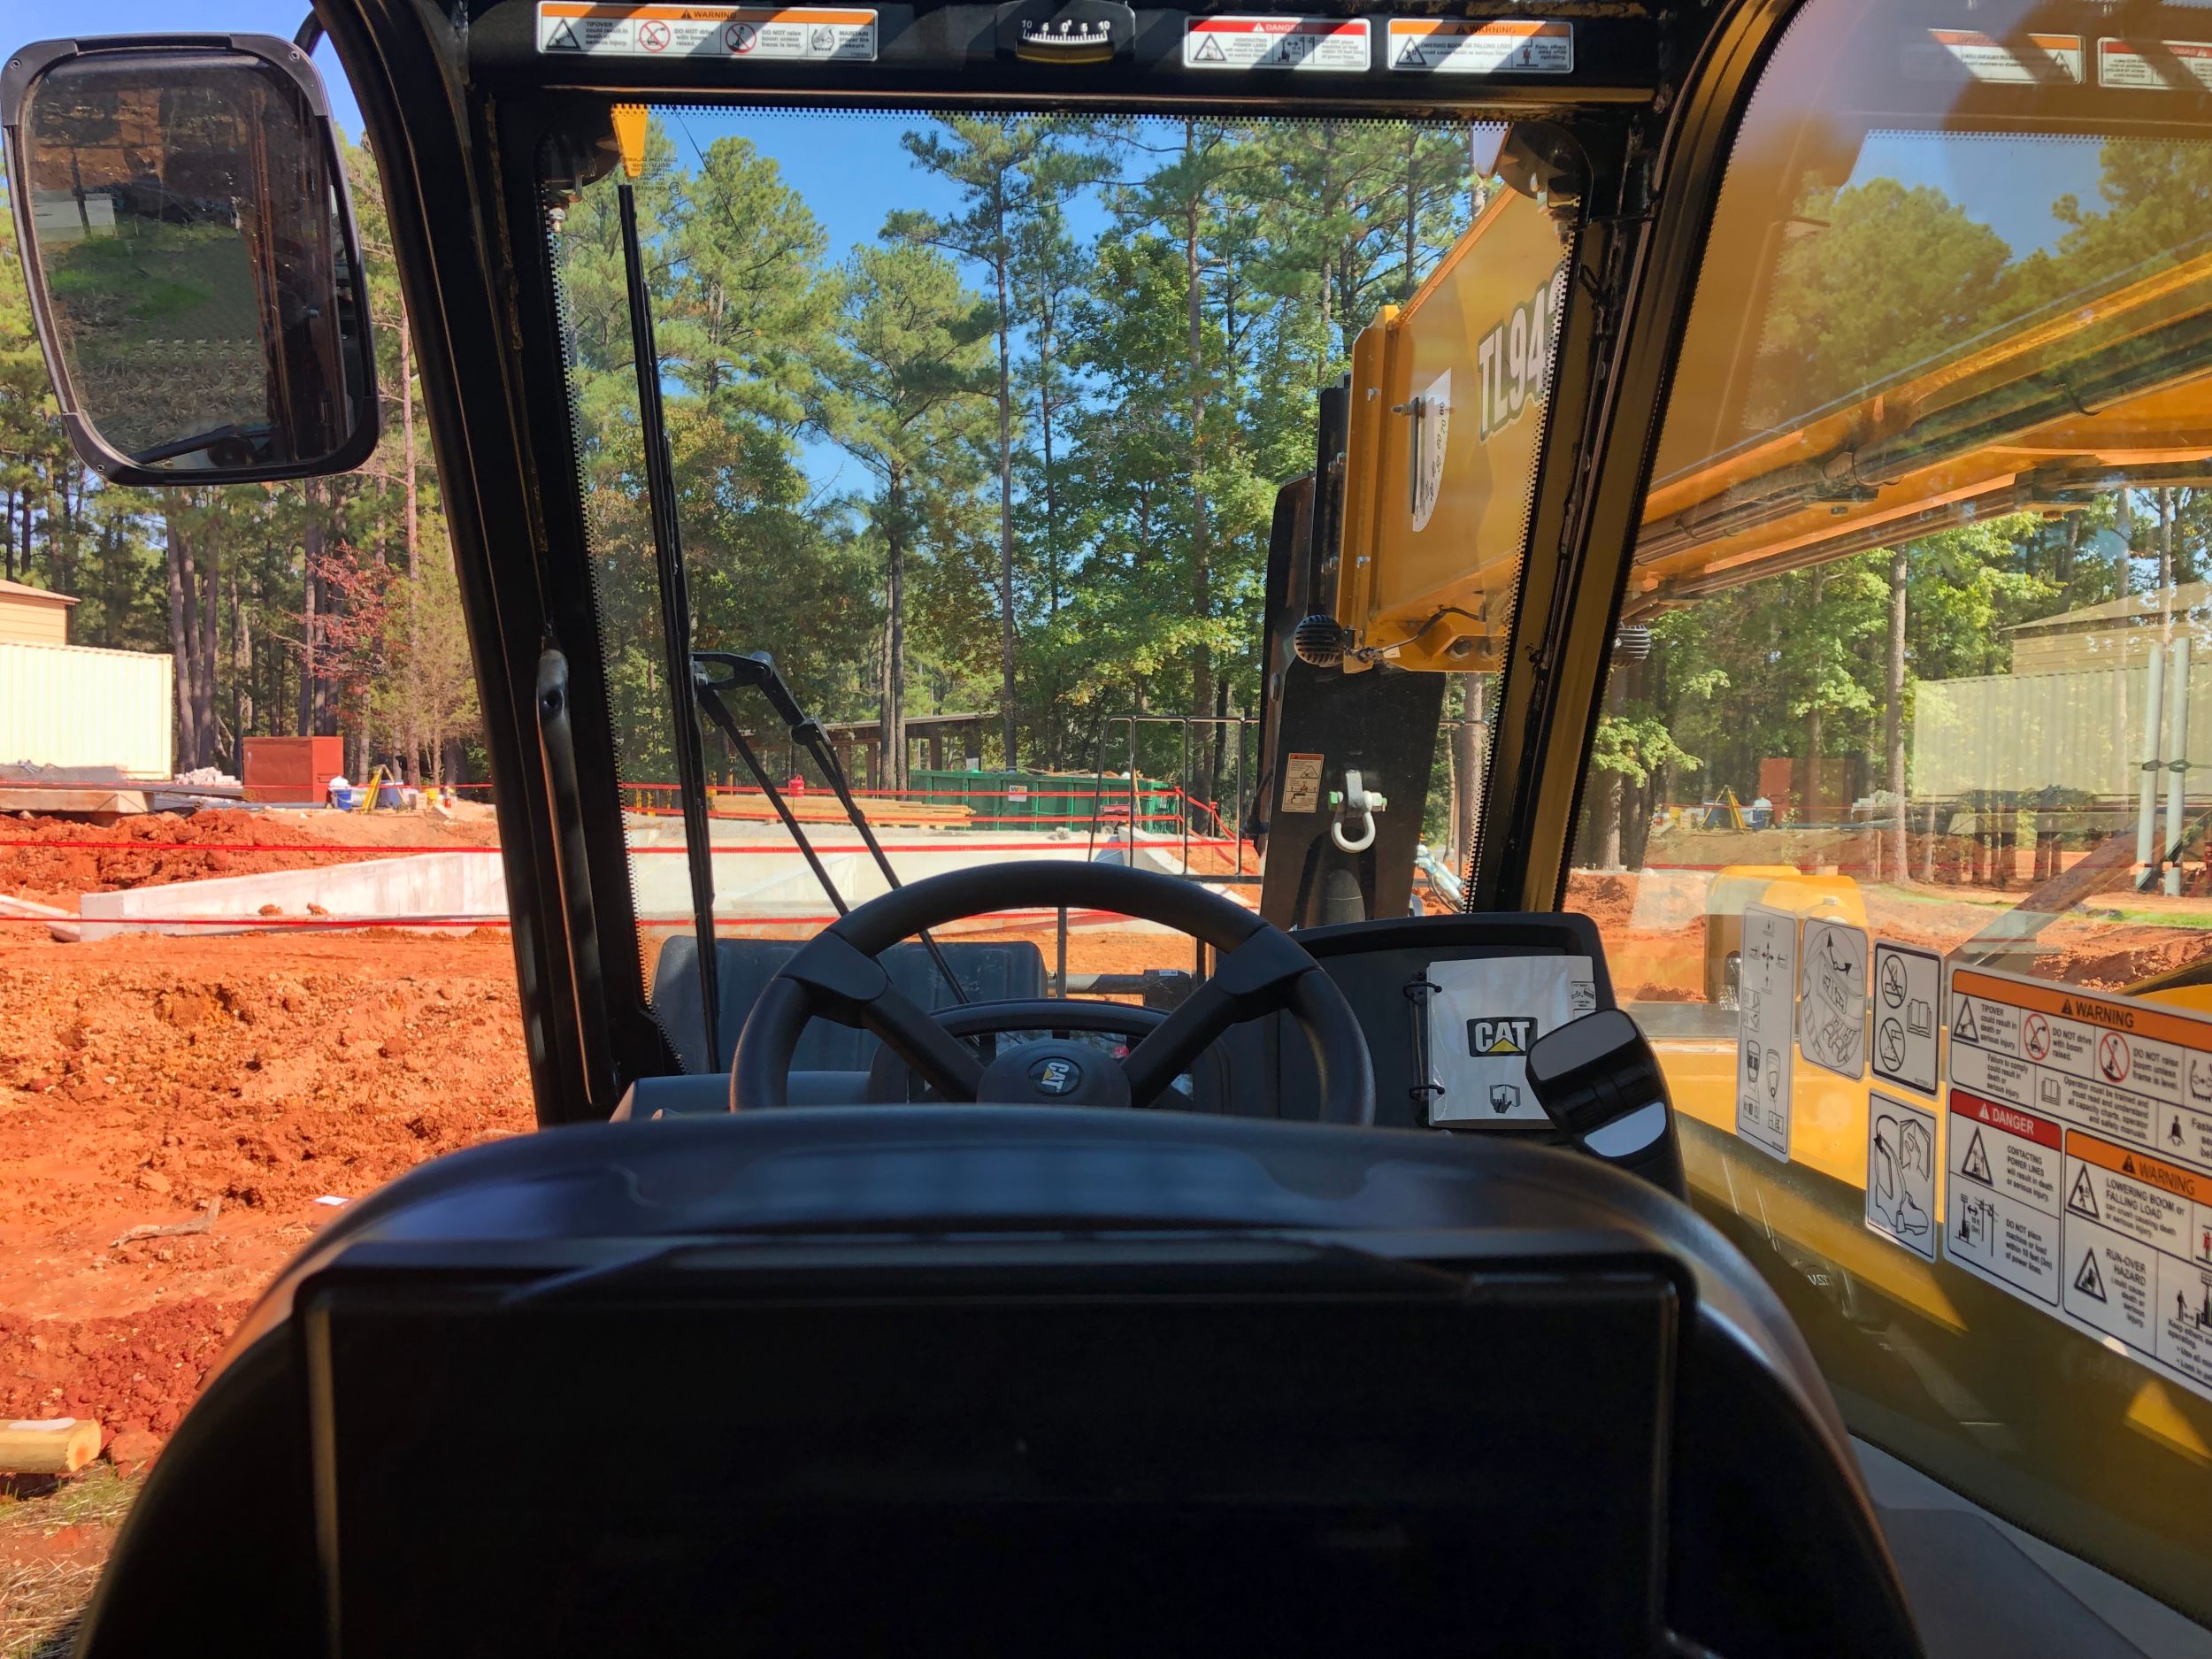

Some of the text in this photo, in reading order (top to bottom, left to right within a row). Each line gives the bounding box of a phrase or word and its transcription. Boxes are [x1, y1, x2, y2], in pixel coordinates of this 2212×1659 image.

[1022, 19, 1033, 29] 10
[1041, 22, 1049, 32] 5
[1080, 22, 1088, 32] 5
[1098, 20, 1110, 30] 10
[1981, 1004, 2004, 1017] TIPOVER
[2076, 1001, 2134, 1028] WARNING
[1475, 1022, 1529, 1053] CAT
[2053, 1027, 2062, 1039] DO
[2062, 1030, 2076, 1041] NOT
[2133, 1048, 2144, 1058] DO
[2146, 1051, 2161, 1062] NOT
[1041, 1062, 1070, 1093] CAT
[2064, 1076, 2088, 1090] Operator
[1993, 1108, 2034, 1135] DANGER
[2007, 1145, 2043, 1165] CONTACTING
[2007, 1156, 2045, 1177] POWER LINES
[2139, 1162, 2194, 1195] WARNING
[2106, 1178, 2147, 1202] LOWERING
[2150, 1193, 2175, 1210] BOOM
[2106, 1190, 2162, 1219] FALLING LOAD
[2006, 1217, 2015, 1229] DO
[2015, 1223, 2026, 1234] NOT
[2106, 1248, 2147, 1275] RUN-OVER
[2114, 1263, 2147, 1286] HAZARD
